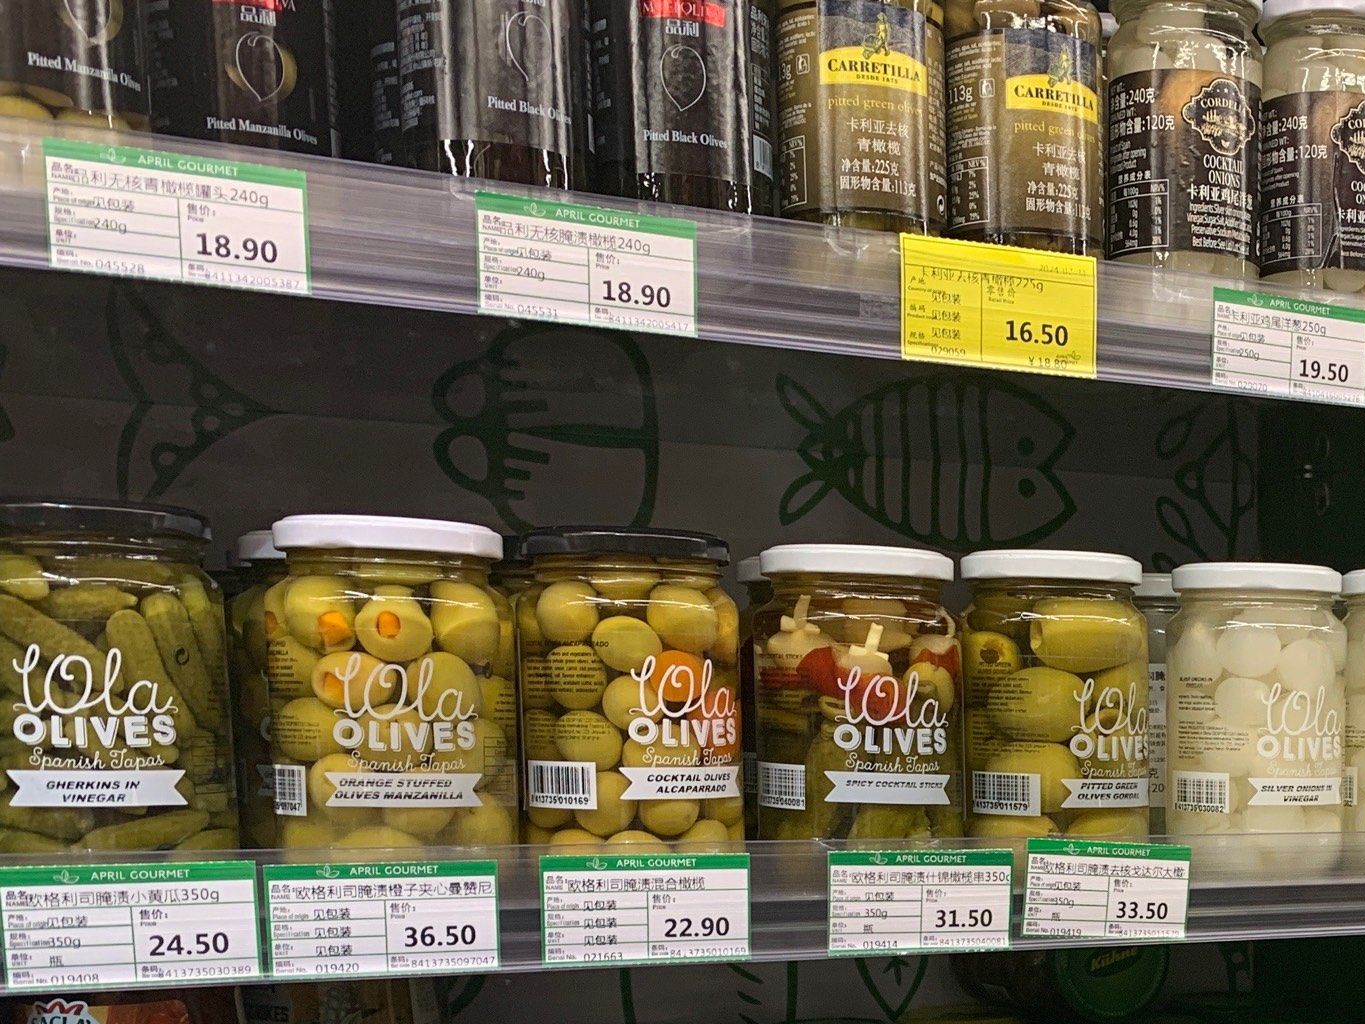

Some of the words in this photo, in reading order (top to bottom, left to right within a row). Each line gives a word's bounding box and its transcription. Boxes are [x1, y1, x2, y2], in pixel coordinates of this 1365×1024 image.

[827, 58, 921, 83] CARRETILLA
[1014, 83, 1094, 112] CARRETILLA
[846, 116, 910, 139] 卡利亚去核
[857, 138, 901, 157] 青橄榄
[1044, 161, 1081, 181] 青橄榄
[196, 232, 278, 263] 18.90
[601, 279, 672, 308] 18.90
[1004, 319, 1069, 346] 16.50
[1299, 359, 1349, 383] 19.50
[13, 715, 177, 749] OLIVES
[333, 718, 476, 753] OLIVES
[628, 718, 737, 747] OLIVES
[834, 723, 948, 756] OLIVES
[46, 780, 122, 790] GHERKINS
[125, 780, 140, 790] IN
[339, 778, 393, 788] ORANGE
[396, 777, 453, 788] STUFFED
[646, 773, 702, 783] COCKTAIL
[704, 773, 731, 782] OLIVES
[1081, 782, 1114, 791] PITTED
[1115, 782, 1138, 791] GREEN
[62, 793, 127, 804] VINEGAR
[334, 791, 380, 801] OLIVES
[383, 790, 464, 801] MANZANILLA
[656, 784, 727, 795] ALCAPARRADO
[1283, 794, 1319, 804] VINEGAR
[91, 869, 126, 881] APRIL
[128, 869, 191, 881] GOURMET
[935, 908, 992, 928] 31.50
[1116, 899, 1168, 920] 33.50
[404, 924, 476, 949] 36.50
[664, 917, 730, 938] 22.90
[149, 931, 230, 957] 24.50
